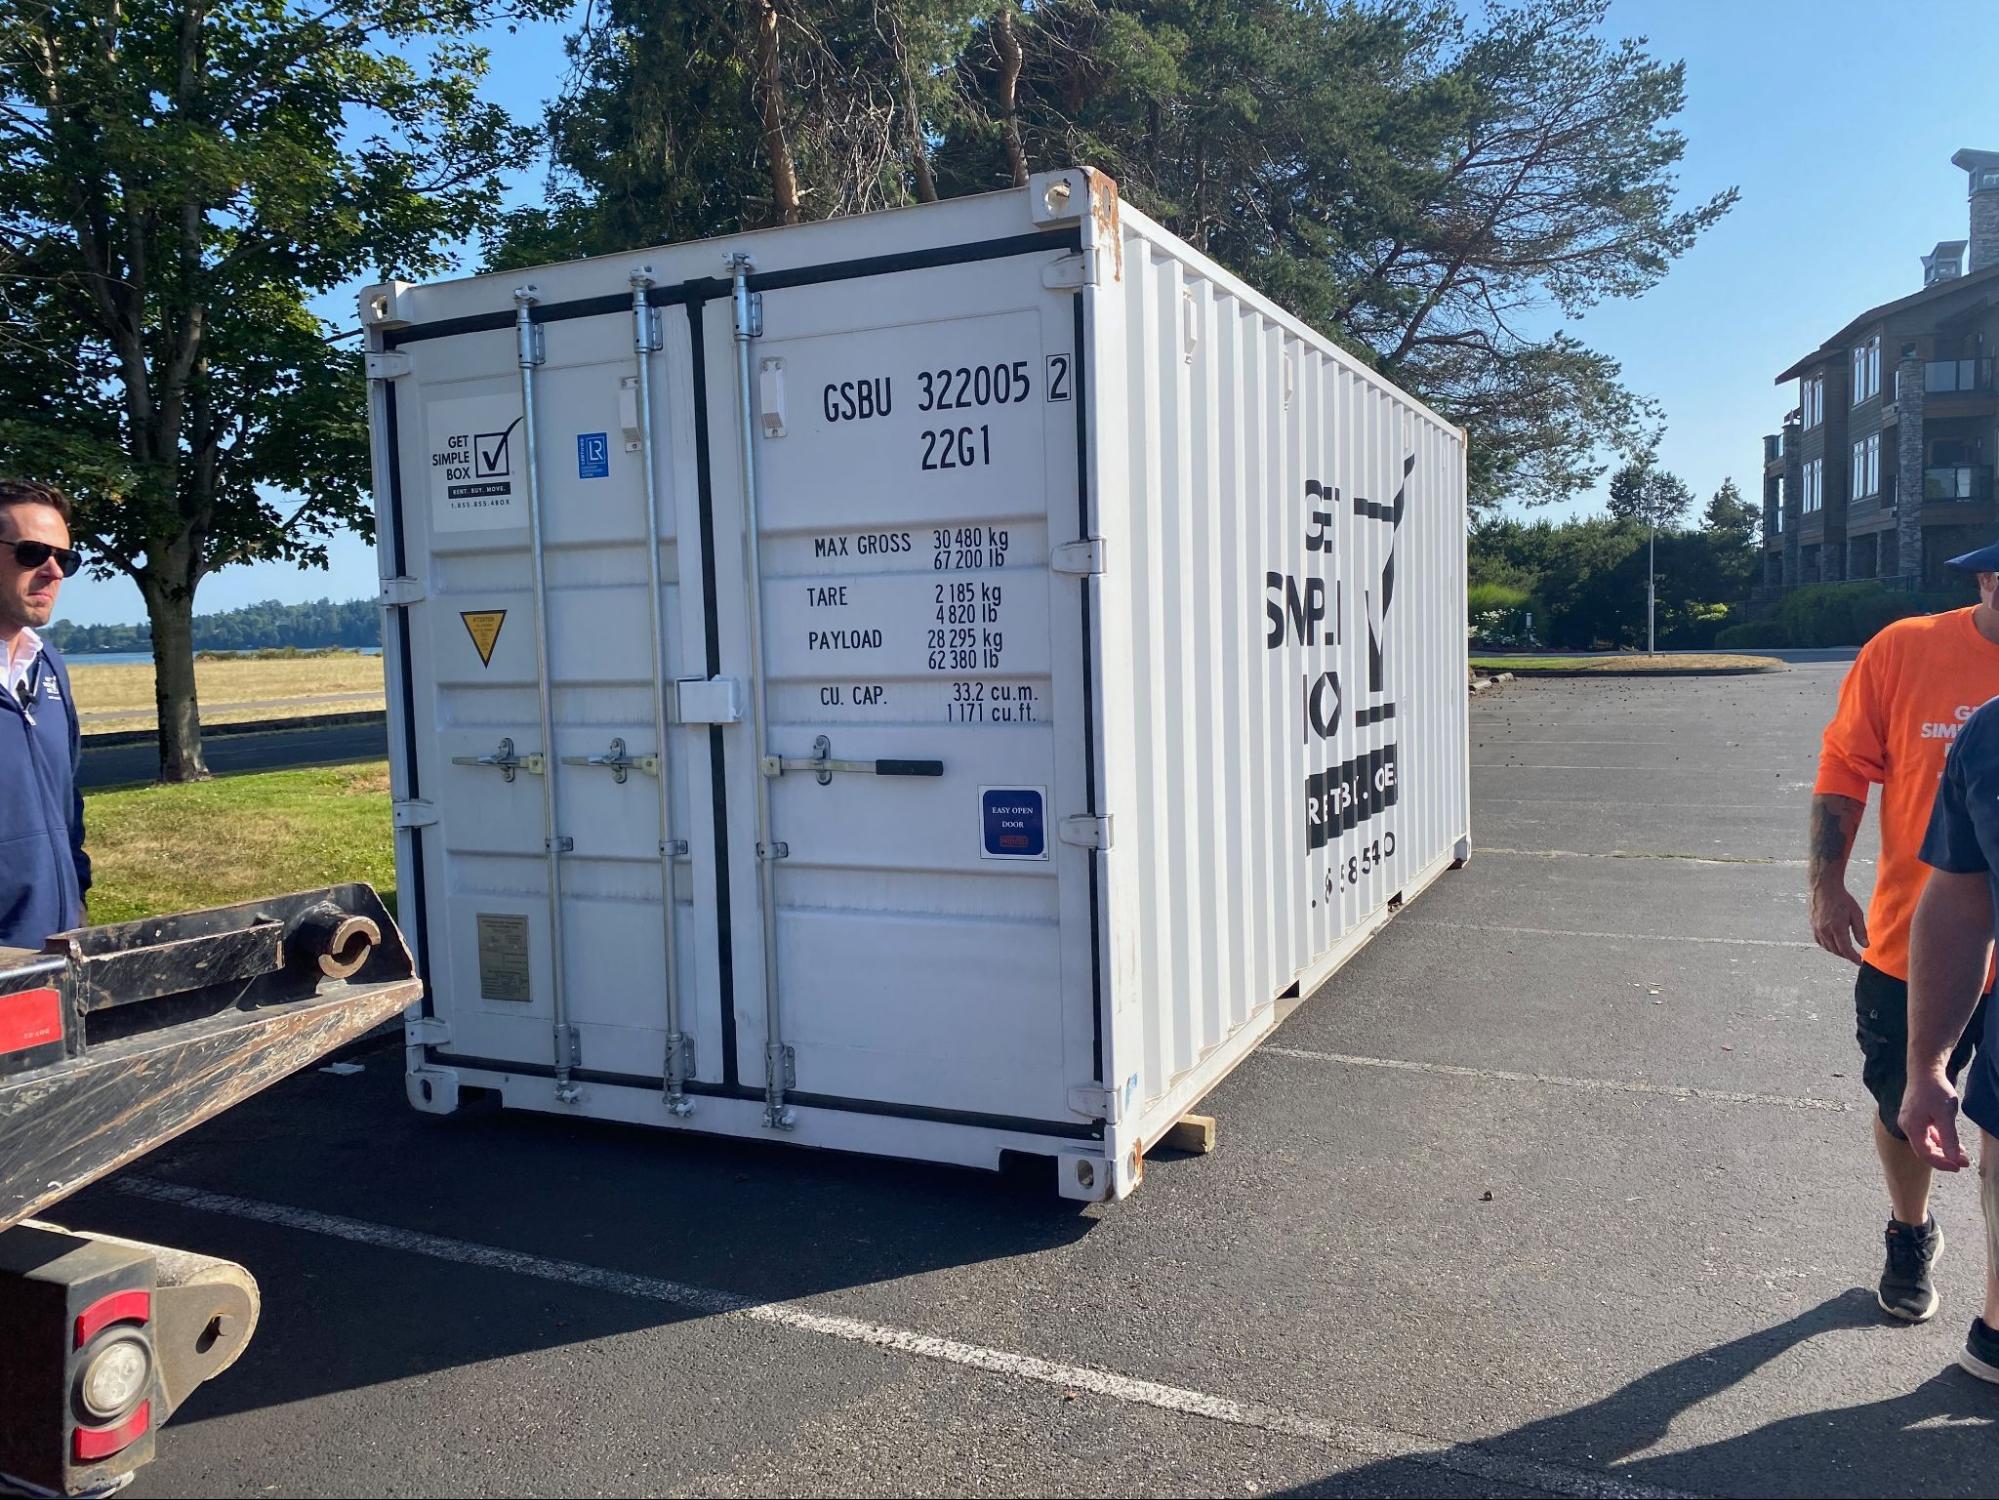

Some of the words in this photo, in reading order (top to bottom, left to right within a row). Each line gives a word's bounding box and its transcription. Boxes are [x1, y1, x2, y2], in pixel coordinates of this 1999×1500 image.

[823, 376, 892, 423] GSBU
[917, 361, 1031, 412] 322005
[1050, 357, 1068, 400] 2
[448, 435, 469, 448] GET
[920, 424, 990, 471] 22G1
[432, 451, 470, 467] SIMPLE
[446, 466, 471, 481] BOX
[814, 537, 849, 558] MAX
[857, 533, 912, 555] GROSS
[988, 526, 1009, 553] kg
[989, 548, 1006, 568] lb
[806, 586, 849, 607] TARE
[981, 581, 1002, 607] kg
[982, 601, 999, 622] lb
[808, 629, 883, 651] PAYLOAD
[982, 627, 1003, 653] kg
[983, 648, 1001, 669] lb
[820, 686, 845, 706] CU.
[852, 685, 888, 706] CAP.
[952, 682, 985, 702] 33.2
[990, 684, 1039, 701] cu.m.
[991, 703, 1037, 722] cu.ft.
[992, 806, 1010, 814] EASY
[1011, 806, 1033, 814] OPEN
[1001, 821, 1024, 829] DOOR
